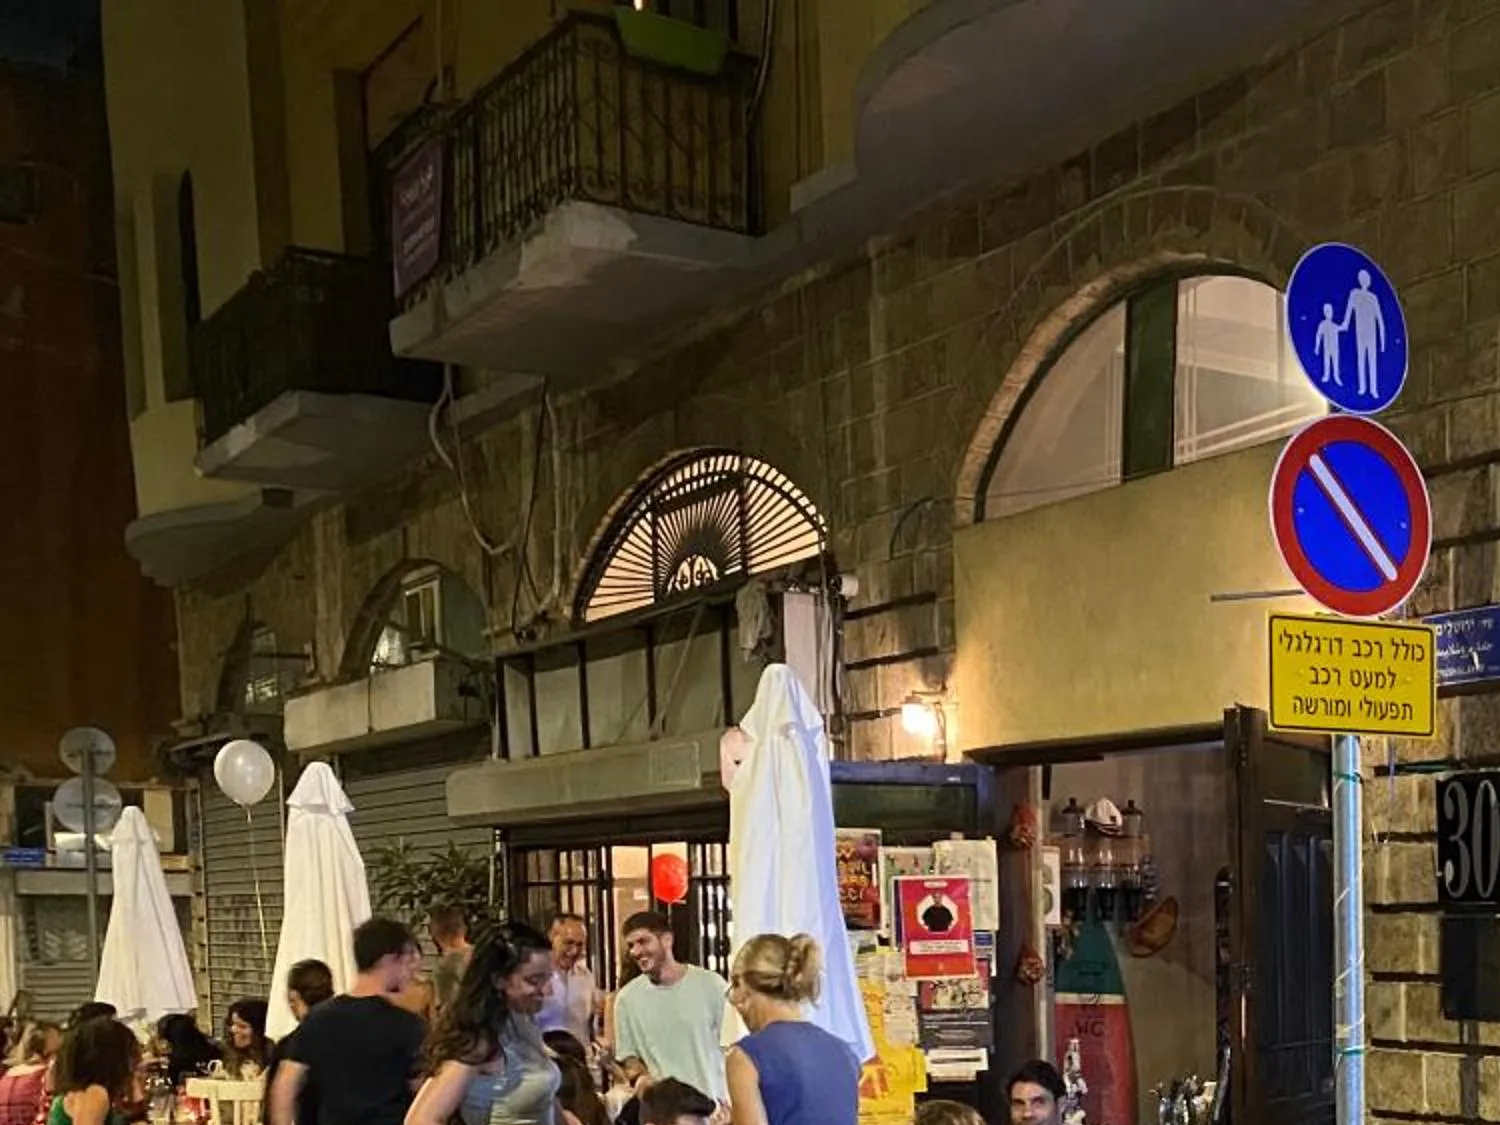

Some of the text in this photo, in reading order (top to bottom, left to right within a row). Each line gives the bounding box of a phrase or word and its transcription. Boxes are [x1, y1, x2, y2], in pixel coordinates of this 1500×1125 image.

[1351, 638, 1383, 660] רכב
[1391, 637, 1425, 662] כולל
[1309, 666, 1397, 690] למעט רכב
[1292, 695, 1413, 721] תפעולי ומורשה
